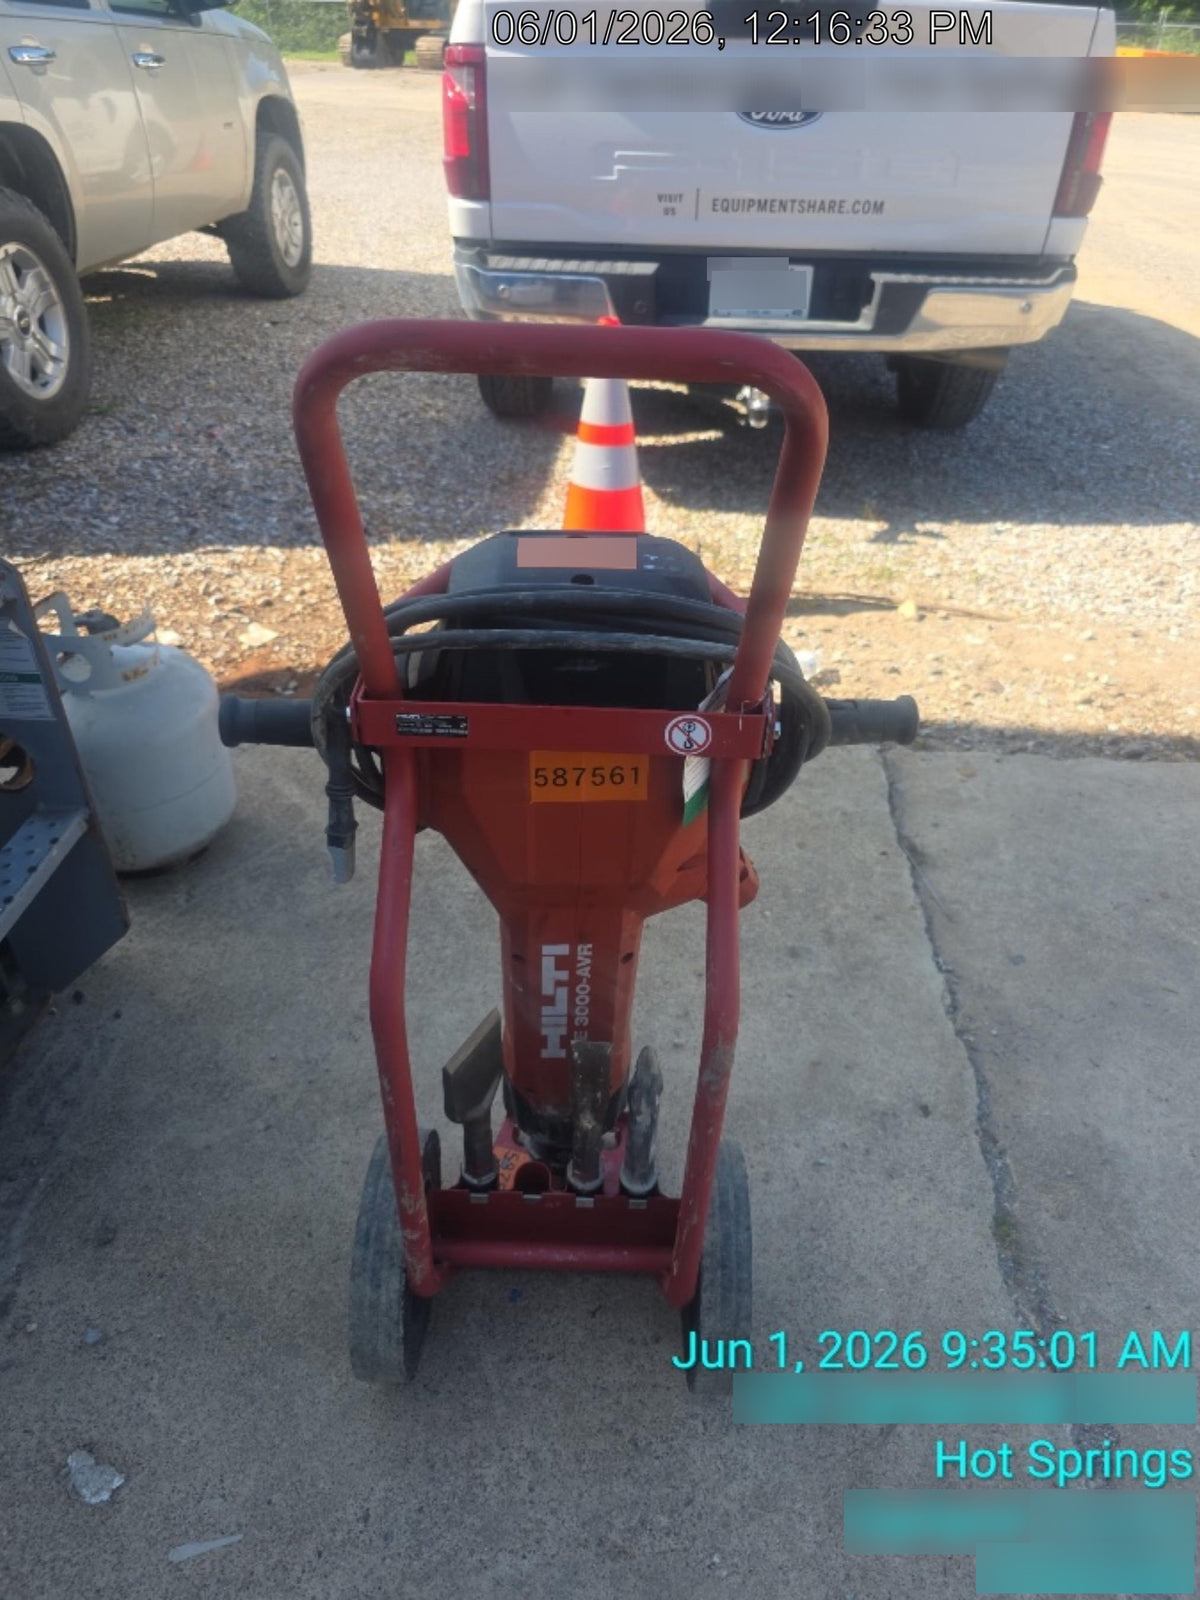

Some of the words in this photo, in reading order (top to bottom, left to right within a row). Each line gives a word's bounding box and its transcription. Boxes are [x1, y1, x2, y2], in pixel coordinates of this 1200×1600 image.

[657, 193, 683, 203] VISIT
[711, 197, 885, 214] EQUIPMENTSHARE.COM
[534, 766, 640, 787] 587561
[574, 943, 593, 1027] 3000-AVR
[541, 944, 570, 1058] HILTI
